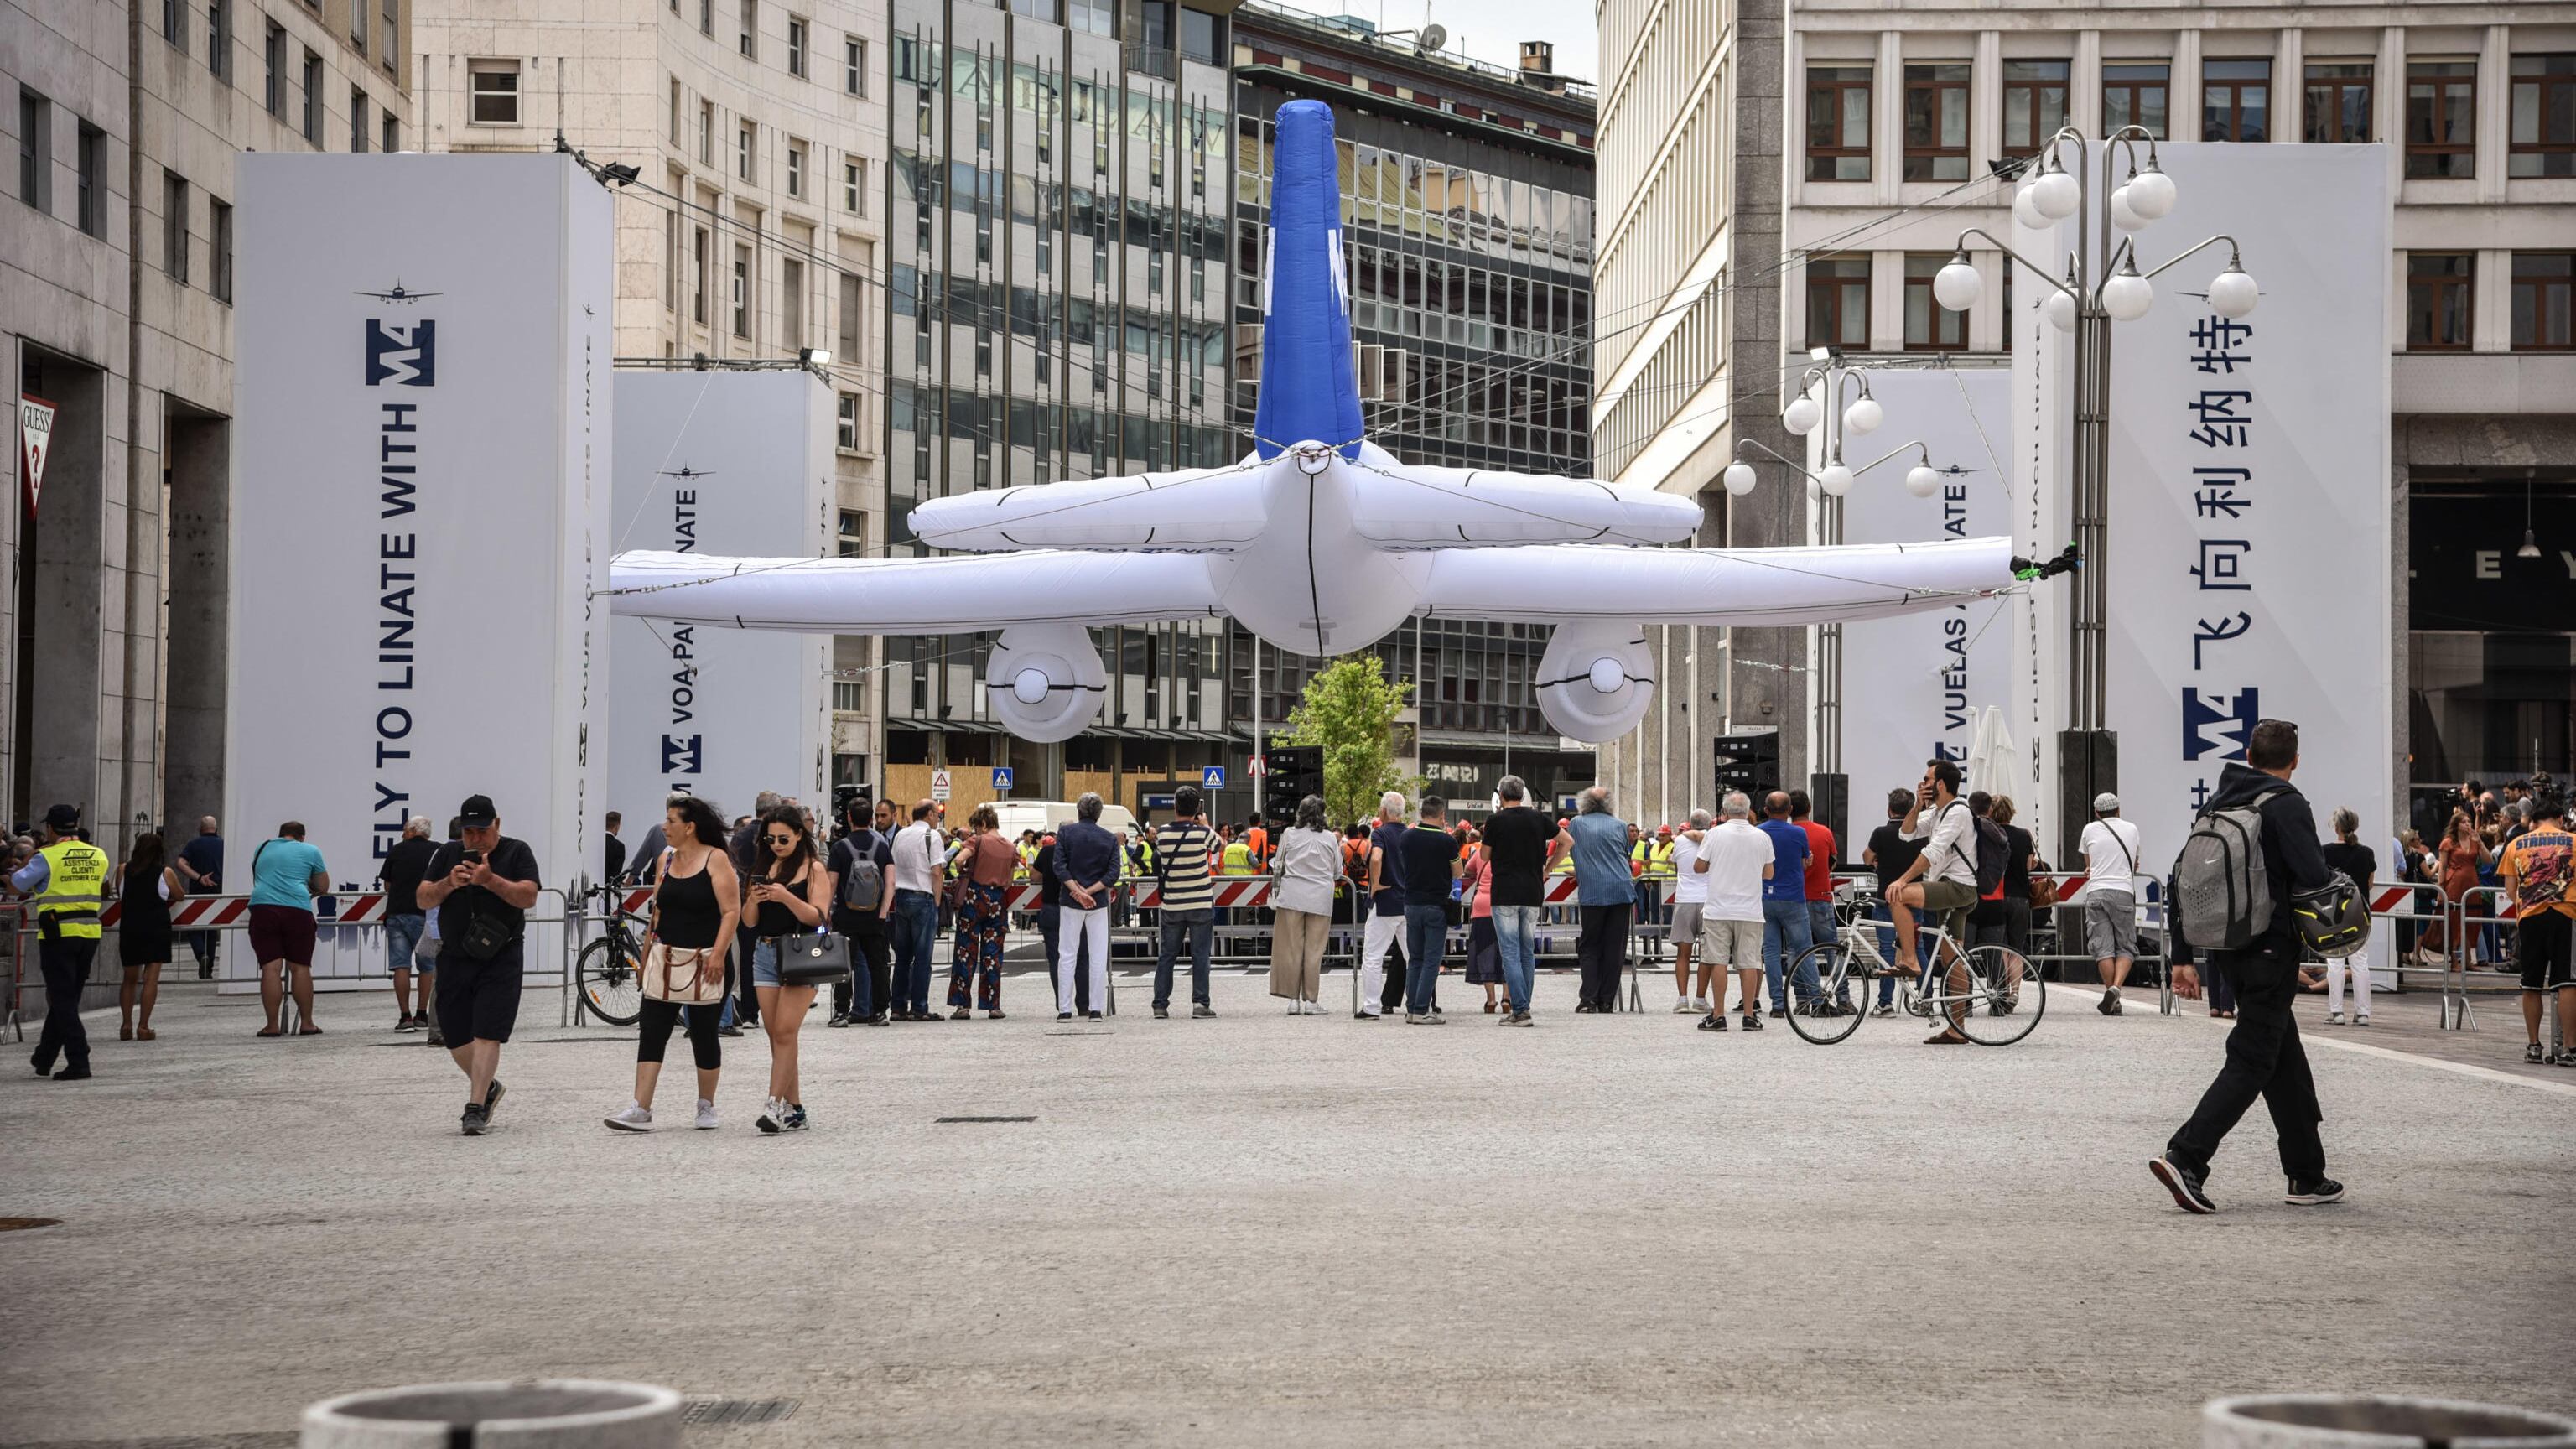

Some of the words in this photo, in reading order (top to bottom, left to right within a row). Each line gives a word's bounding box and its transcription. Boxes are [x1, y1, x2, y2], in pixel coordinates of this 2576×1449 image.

[23, 405, 49, 434] GUESS
[380, 403, 417, 519] WITH
[2189, 315, 2254, 671] 飞向利纳特
[674, 490, 697, 554] NATE
[377, 533, 416, 690] LINATE
[672, 668, 694, 724] VOA
[1944, 617, 1967, 731] VUELAS
[375, 706, 413, 768] TO
[372, 781, 409, 859] FLY
[2516, 836, 2573, 850] STRANGE
[70, 866, 95, 875] CLIENTI
